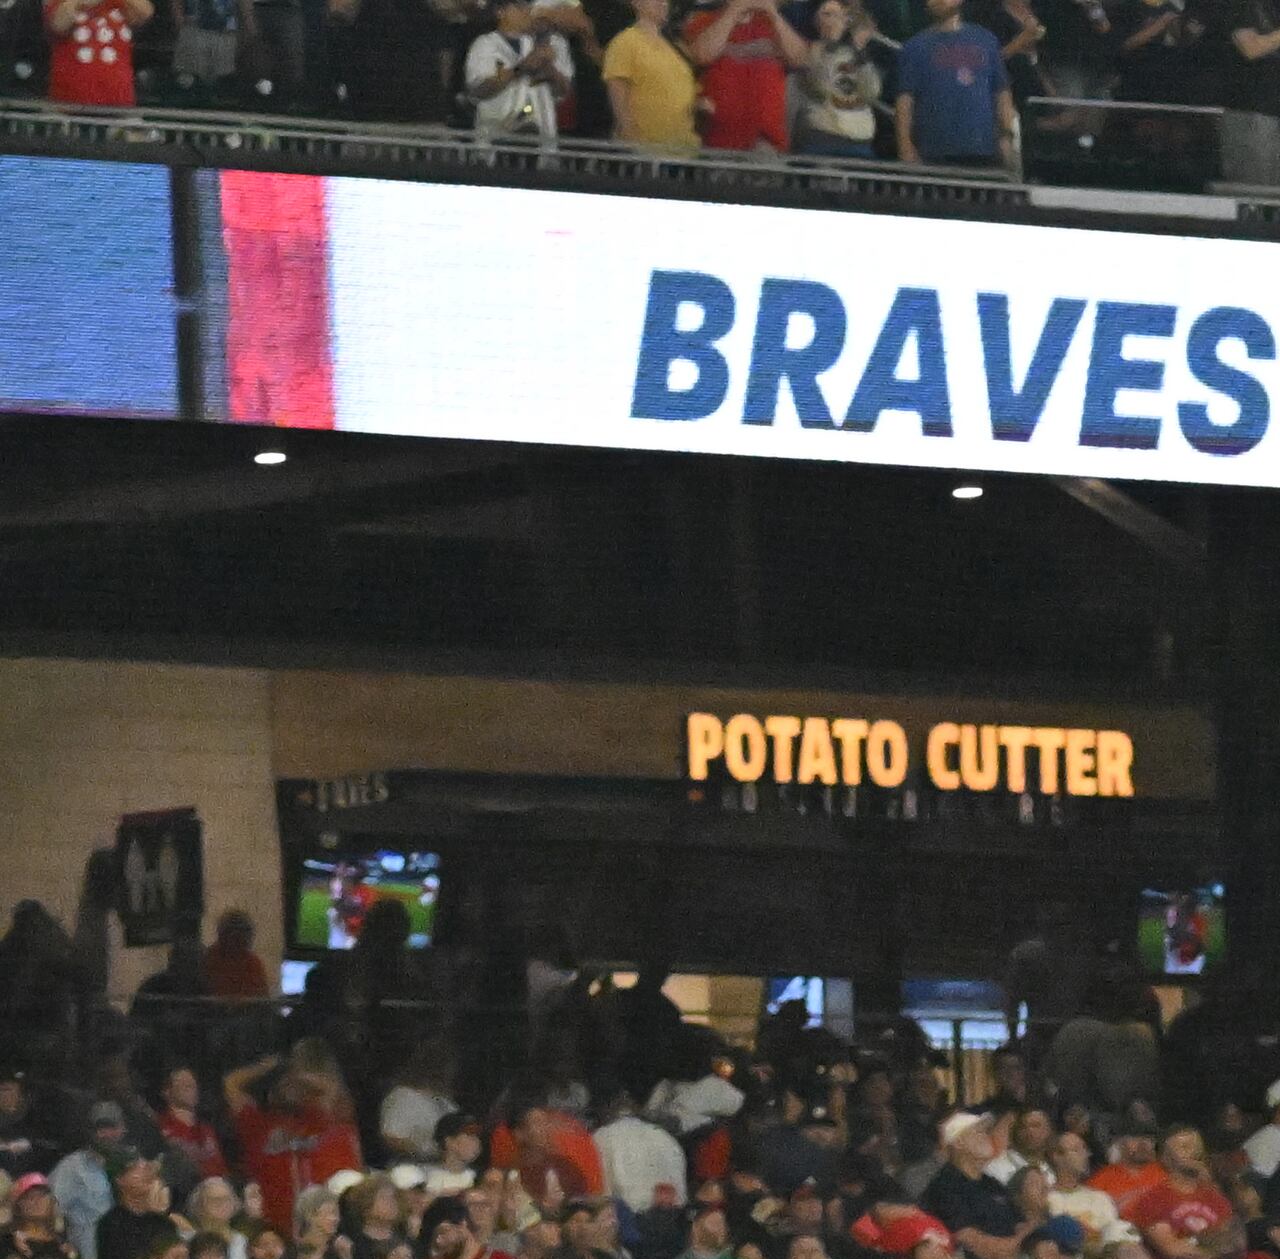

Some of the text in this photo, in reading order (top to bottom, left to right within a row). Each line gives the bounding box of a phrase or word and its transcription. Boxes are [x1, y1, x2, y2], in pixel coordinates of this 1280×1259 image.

[630, 268, 1277, 456] BRAVES
[687, 712, 1135, 797] POTATO CUTTER
